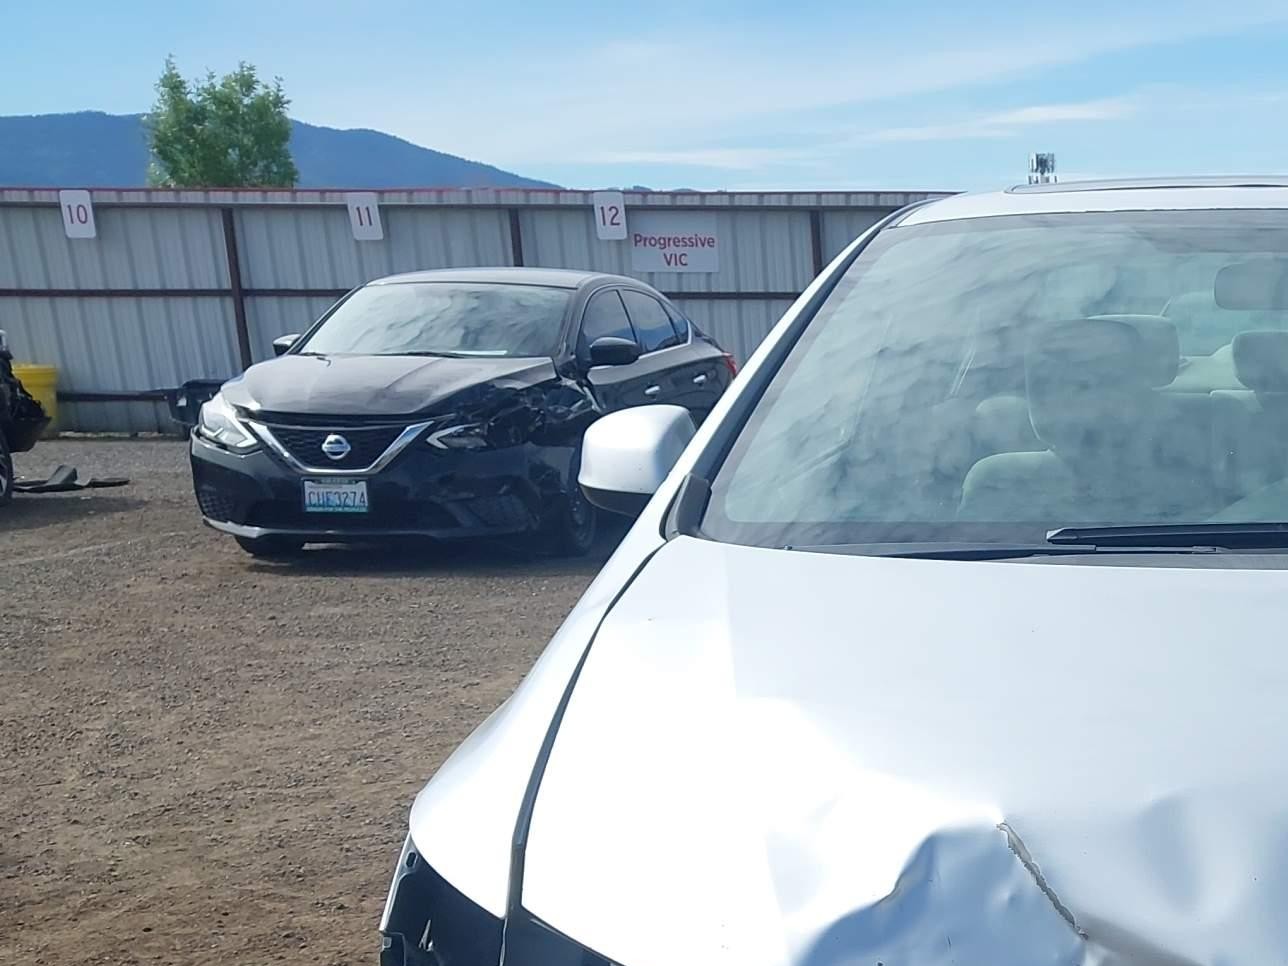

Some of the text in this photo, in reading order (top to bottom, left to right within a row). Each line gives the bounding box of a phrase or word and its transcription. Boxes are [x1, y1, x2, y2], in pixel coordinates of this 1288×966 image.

[65, 203, 88, 226] 10
[355, 205, 373, 227] 11
[600, 205, 621, 227] 12
[633, 233, 716, 250] Progressive
[663, 252, 689, 267] VIC
